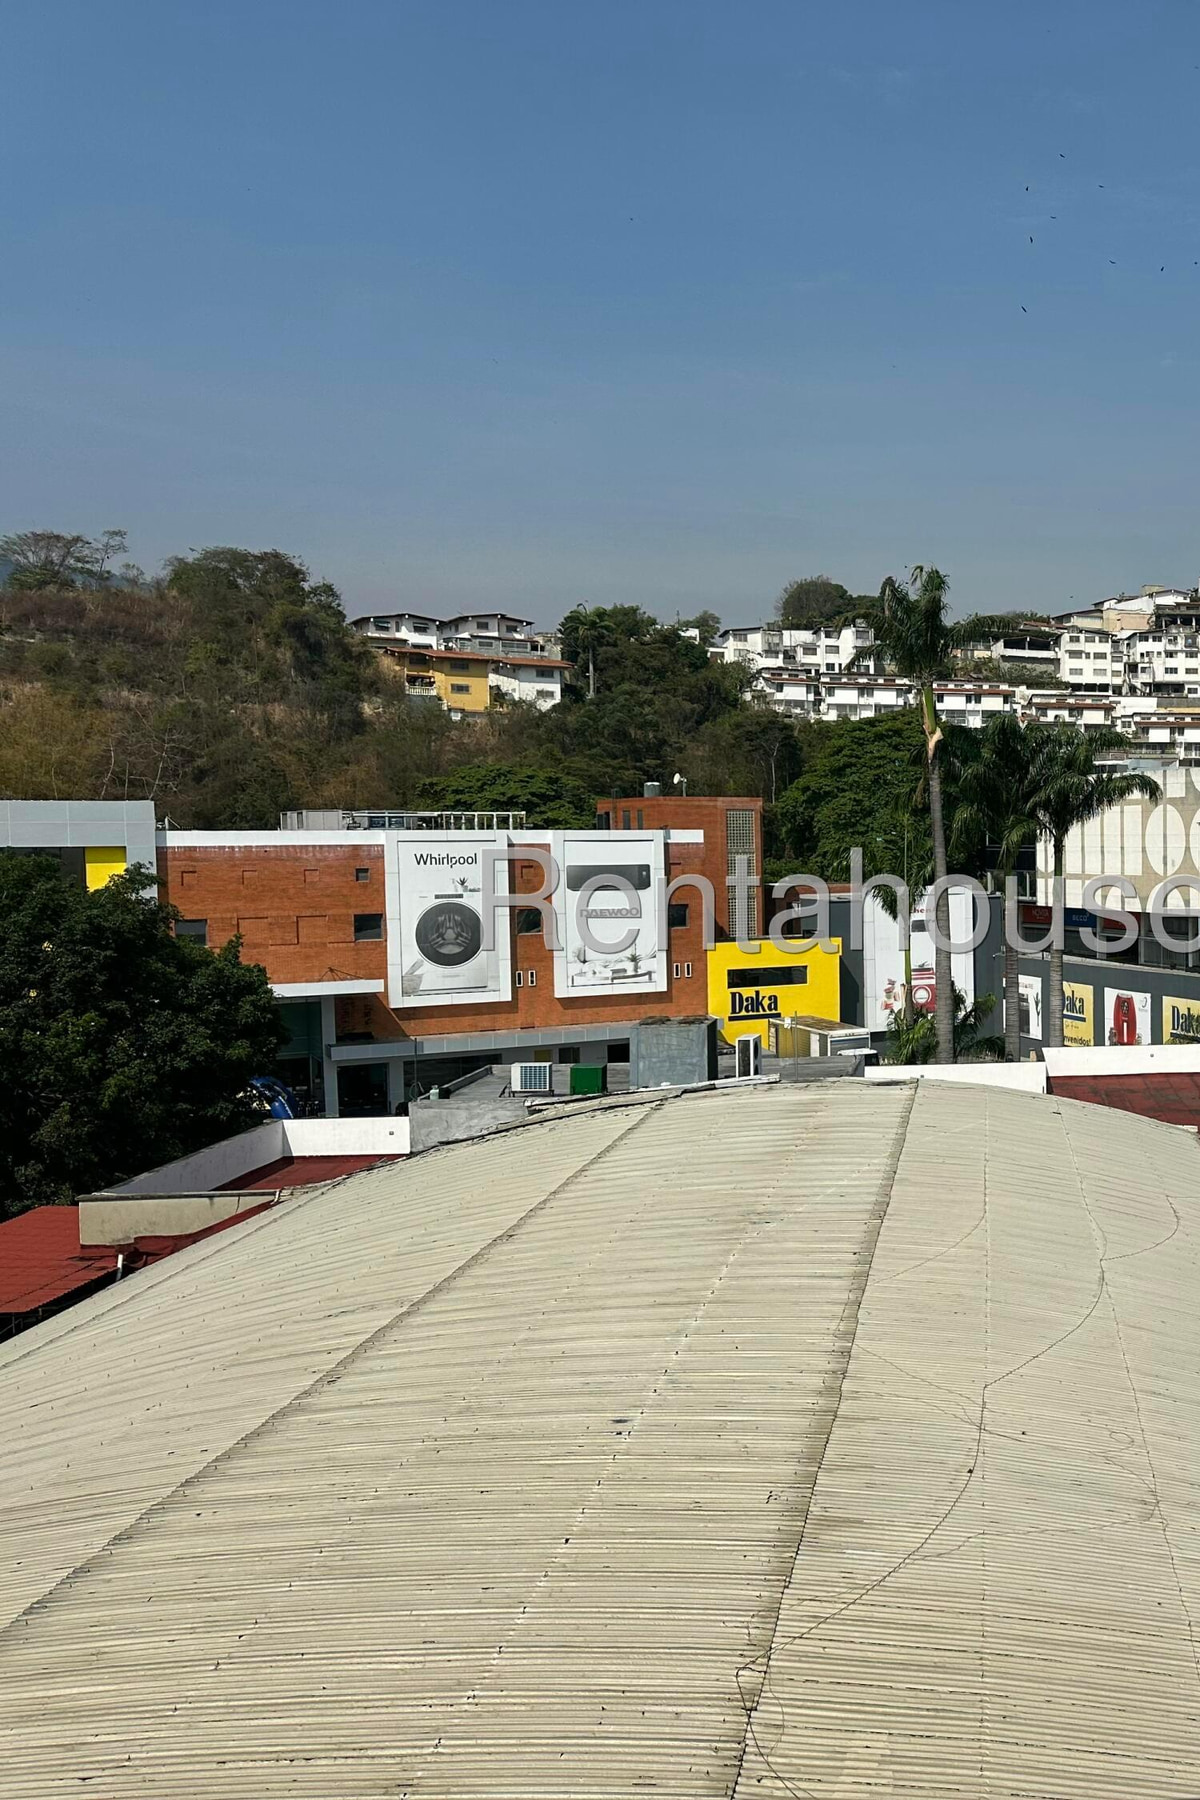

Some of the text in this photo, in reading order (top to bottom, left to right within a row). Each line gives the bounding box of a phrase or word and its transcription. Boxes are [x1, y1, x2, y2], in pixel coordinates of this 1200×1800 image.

[414, 852, 478, 869] Whirlpool
[579, 906, 641, 918] DAEWOO
[729, 990, 779, 1015] Daka
[1063, 1035, 1092, 1047] nvenidos!
